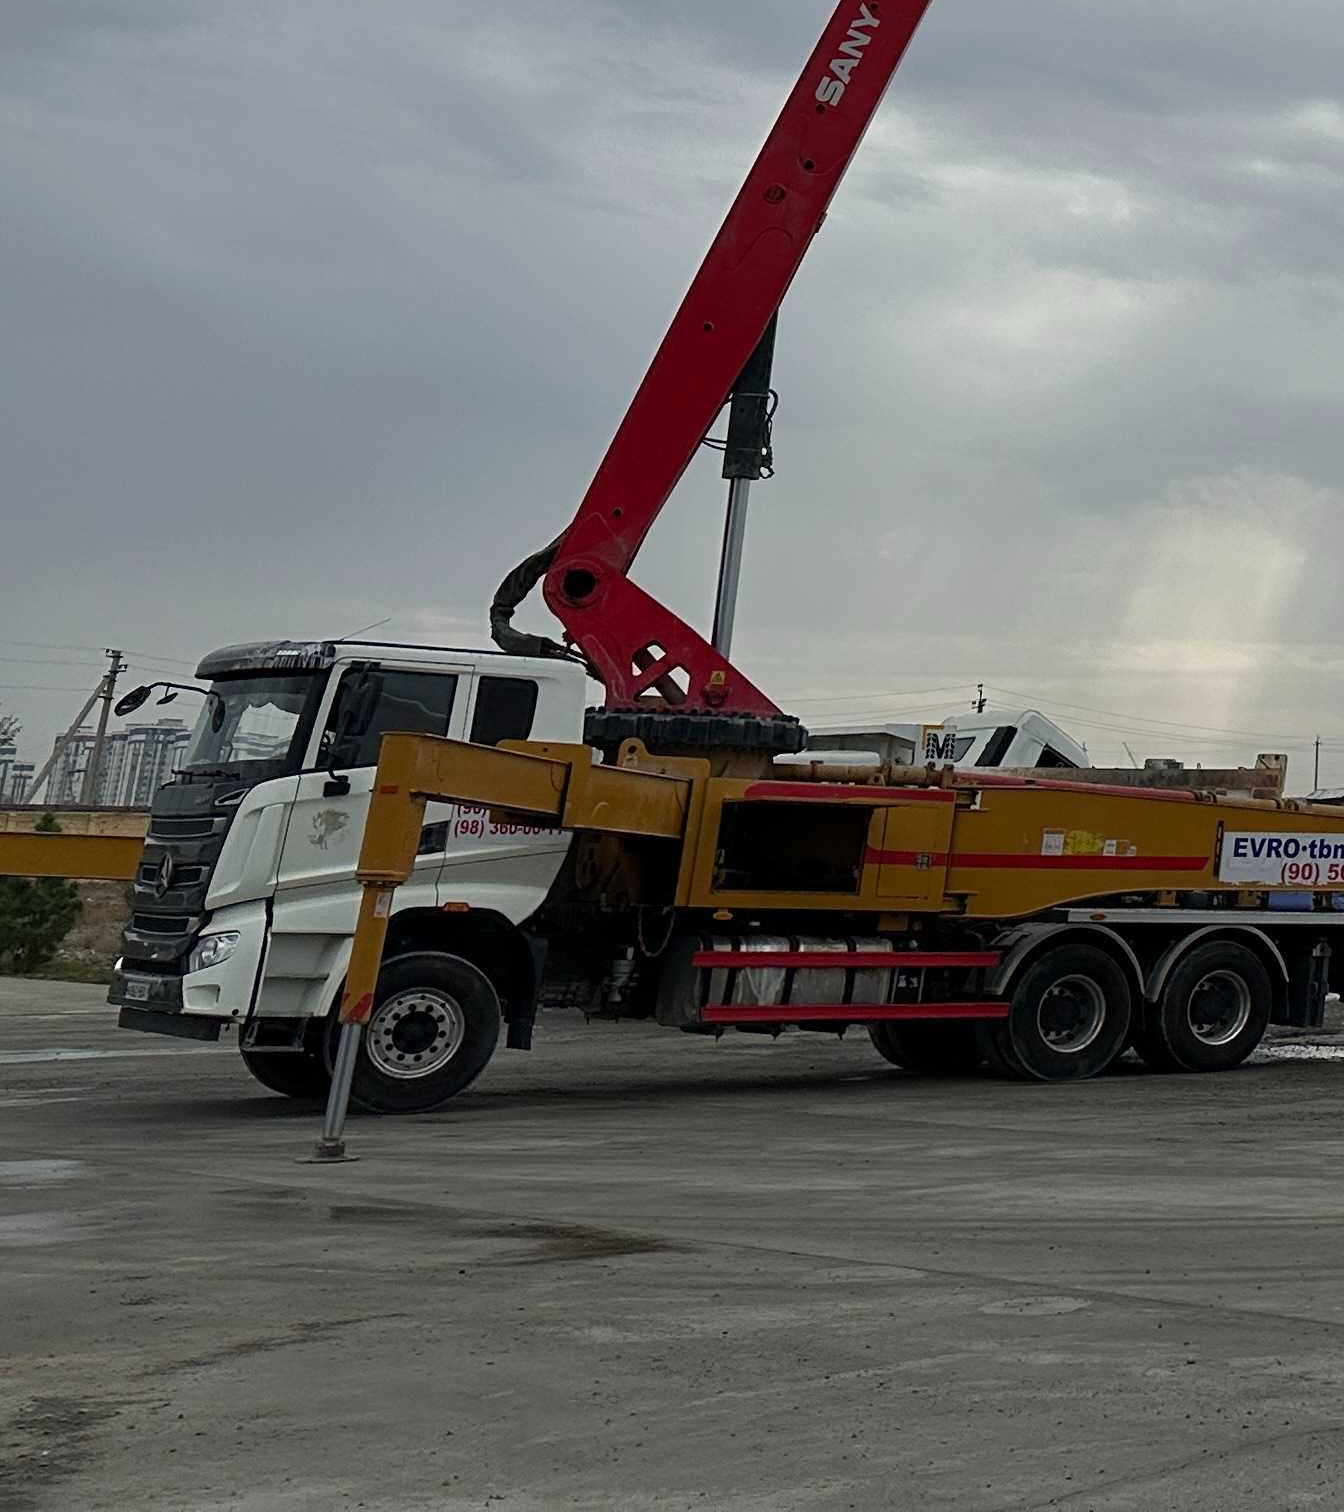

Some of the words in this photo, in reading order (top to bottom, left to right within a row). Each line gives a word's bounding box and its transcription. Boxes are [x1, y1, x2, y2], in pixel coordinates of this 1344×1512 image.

[815, 2, 881, 106] SANY
[454, 819, 485, 838] (98)
[1281, 863, 1320, 884] (90)
